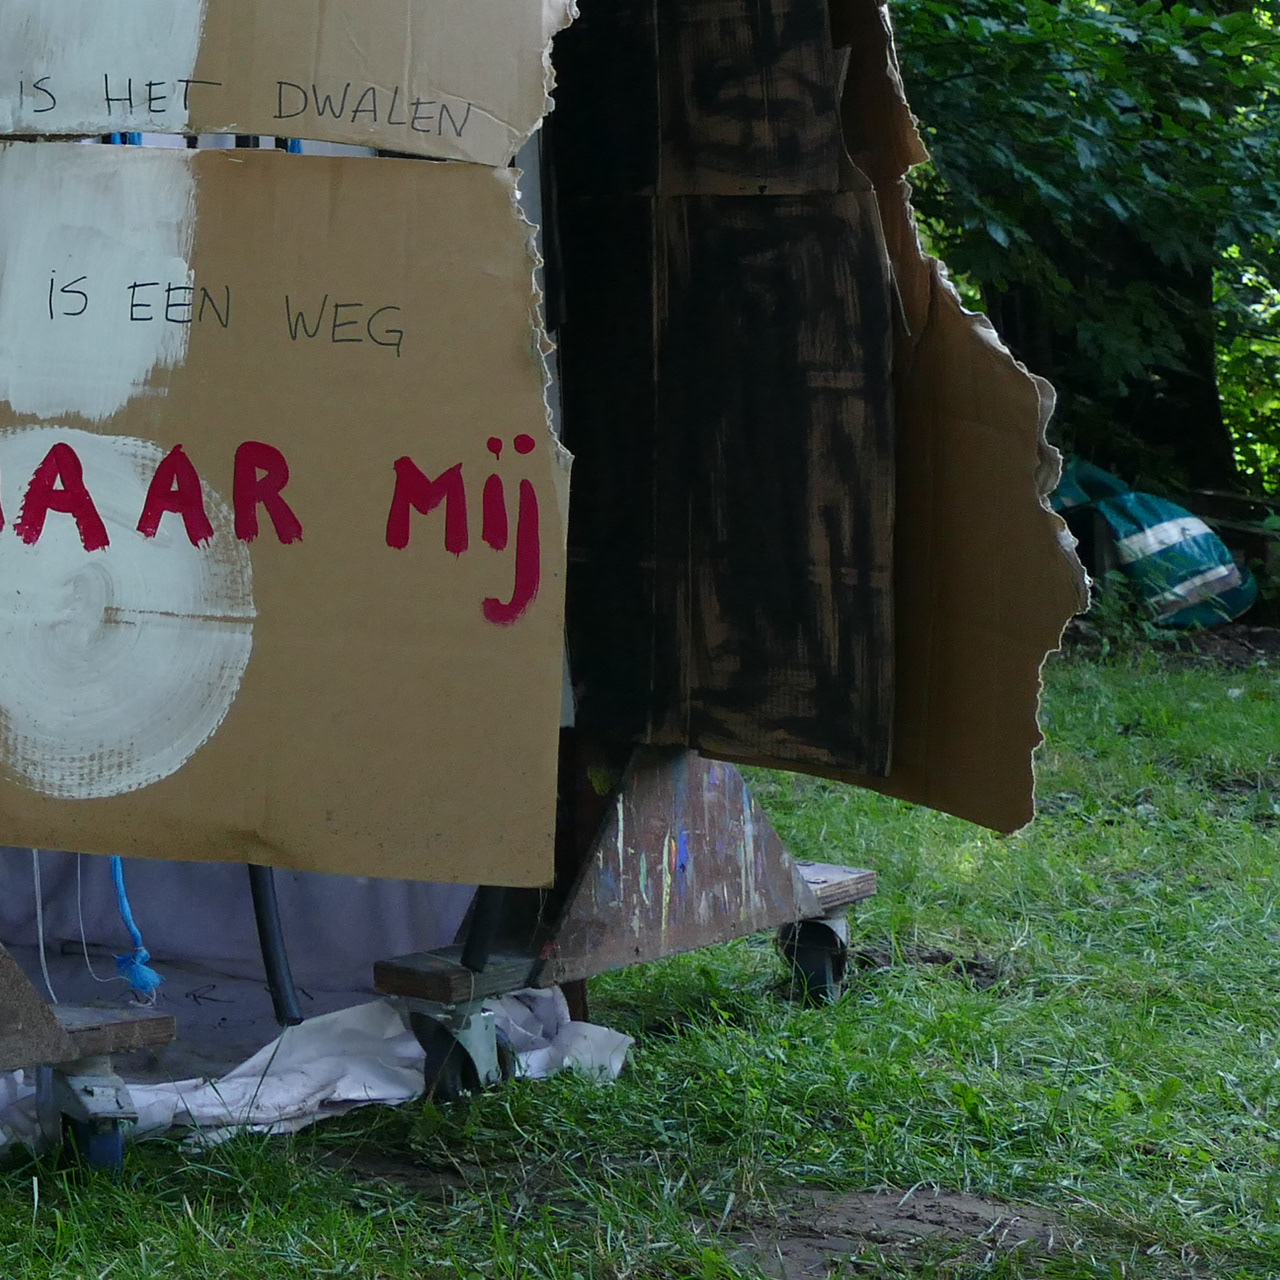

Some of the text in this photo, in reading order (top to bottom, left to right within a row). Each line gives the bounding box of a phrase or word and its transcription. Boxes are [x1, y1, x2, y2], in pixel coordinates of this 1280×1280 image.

[104, 73, 222, 116] HET
[273, 80, 472, 138] DWALEN
[127, 281, 232, 327] EEN
[285, 294, 405, 358] WEG
